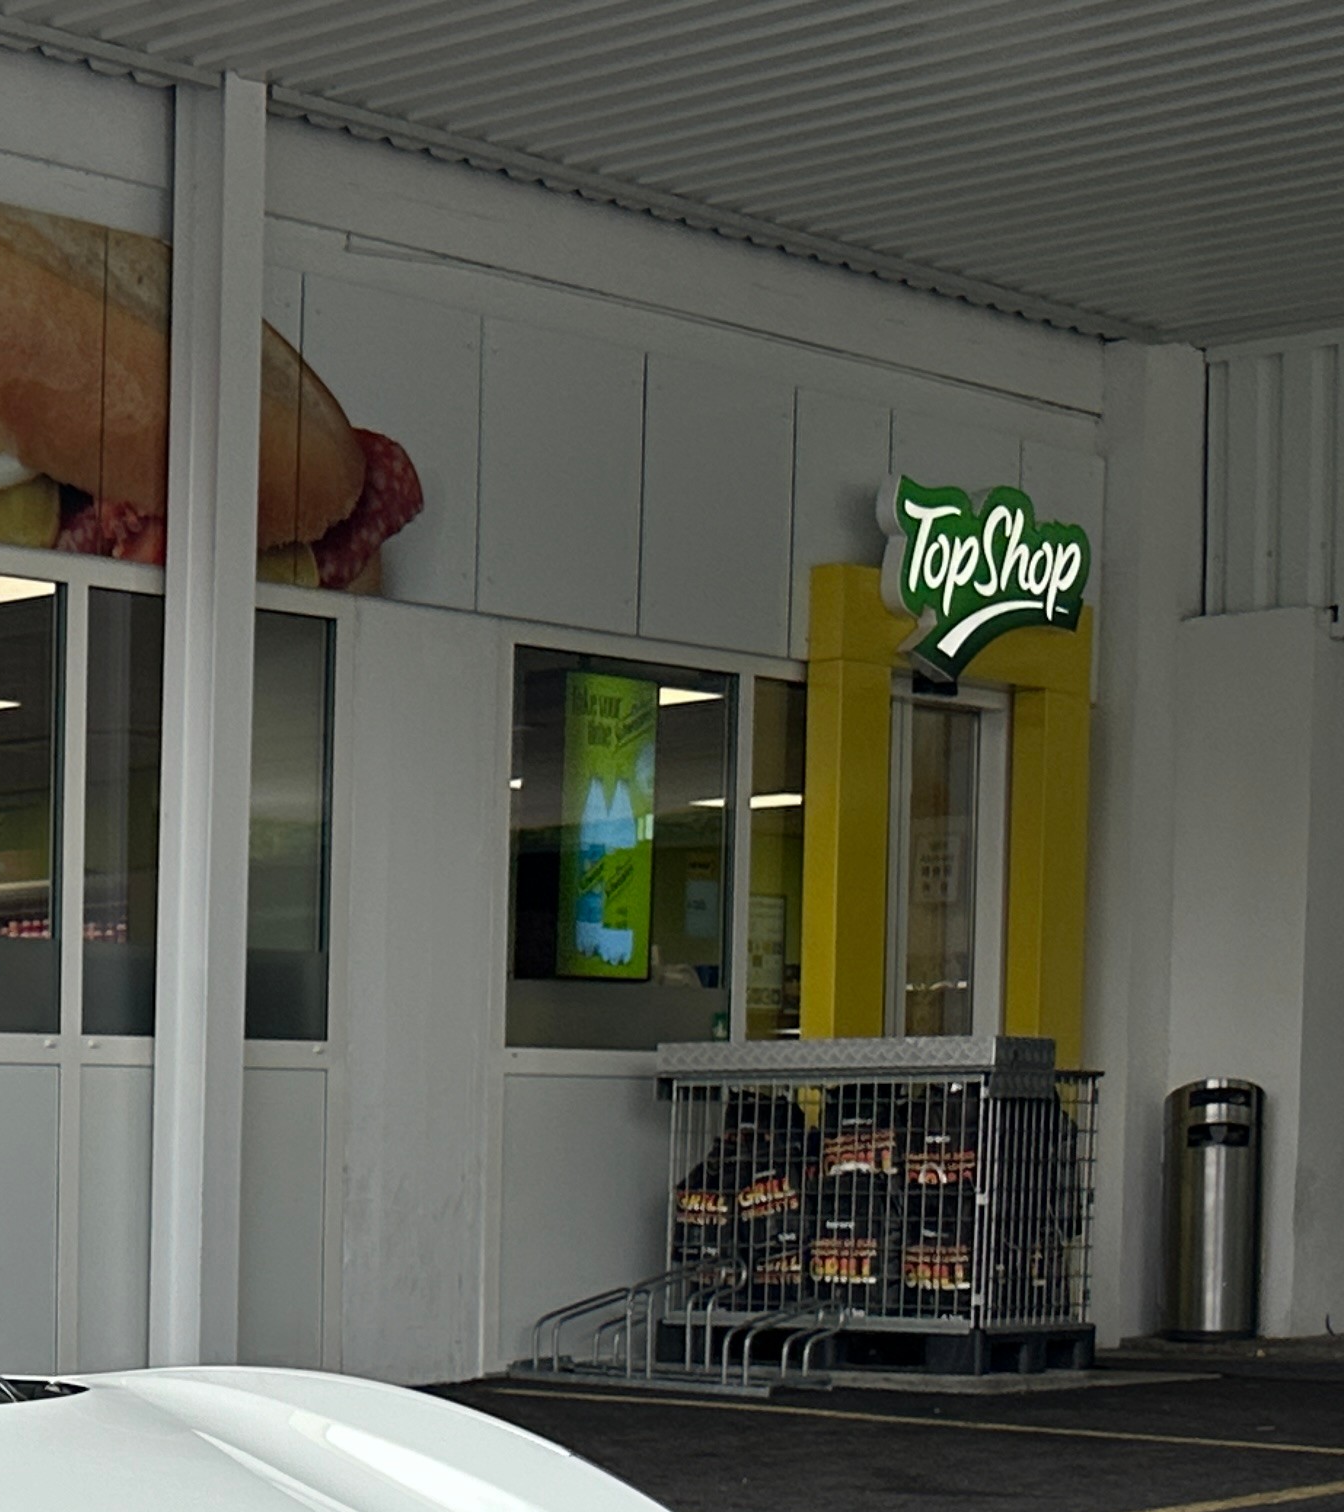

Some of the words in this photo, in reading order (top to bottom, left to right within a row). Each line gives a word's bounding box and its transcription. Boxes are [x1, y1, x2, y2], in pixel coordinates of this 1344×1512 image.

[904, 499, 1082, 622] TopShop
[738, 1178, 796, 1208] GRILL
[809, 1256, 877, 1284] GRILL
